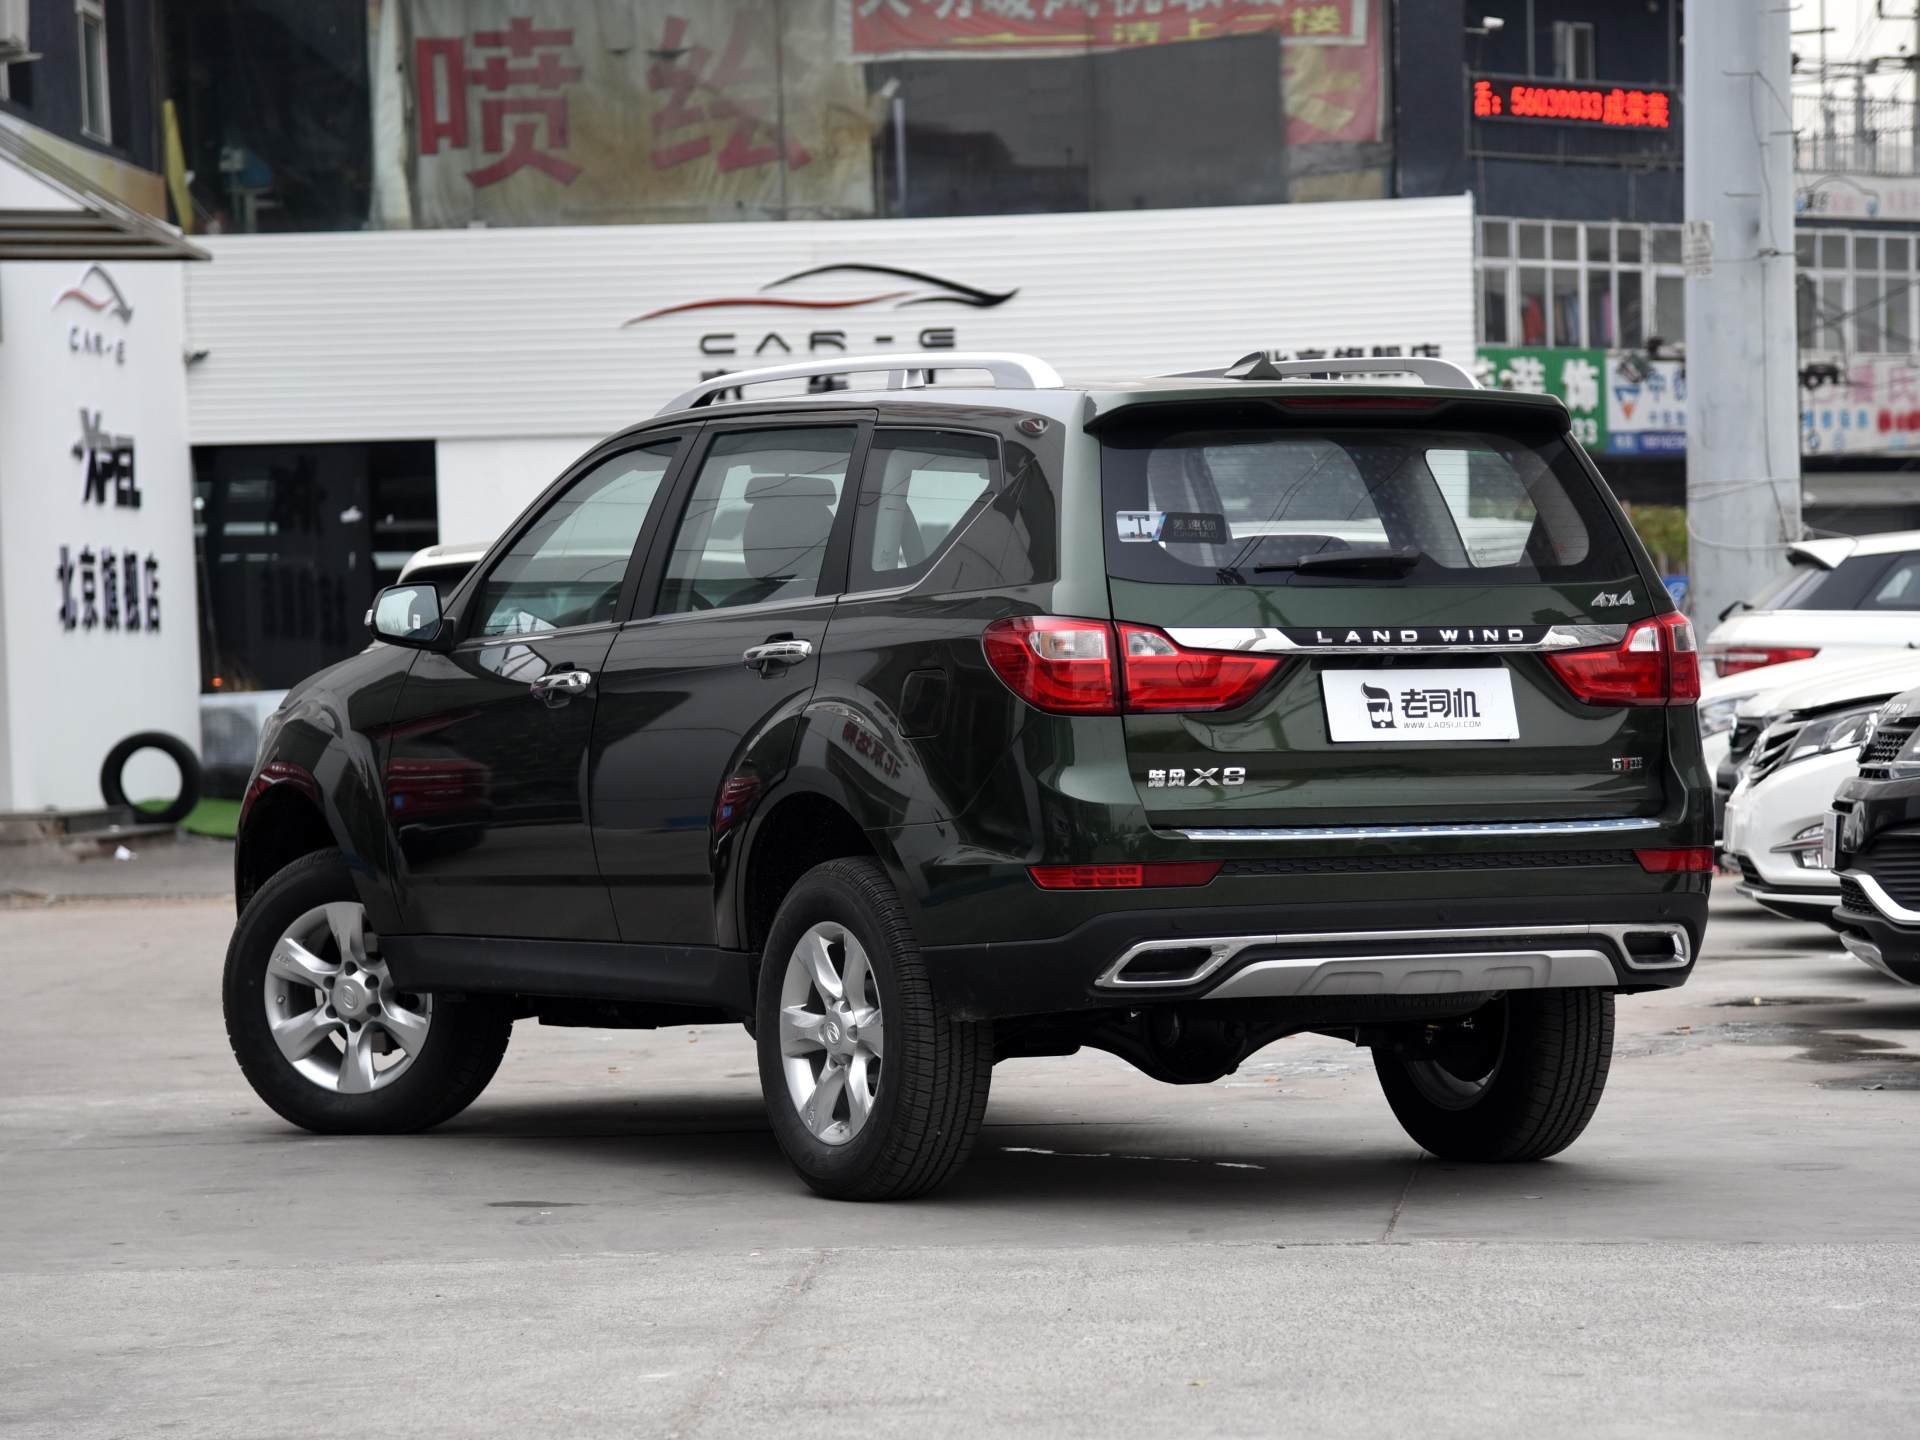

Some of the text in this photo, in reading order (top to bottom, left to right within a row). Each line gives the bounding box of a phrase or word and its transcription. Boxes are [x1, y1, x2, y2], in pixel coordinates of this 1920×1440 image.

[415, 11, 812, 189] 喷绘
[69, 325, 128, 366] CAR-E
[699, 327, 957, 355] CAR-E
[1316, 629, 1524, 644] LAND WIND
[1400, 688, 1481, 719] 老司机
